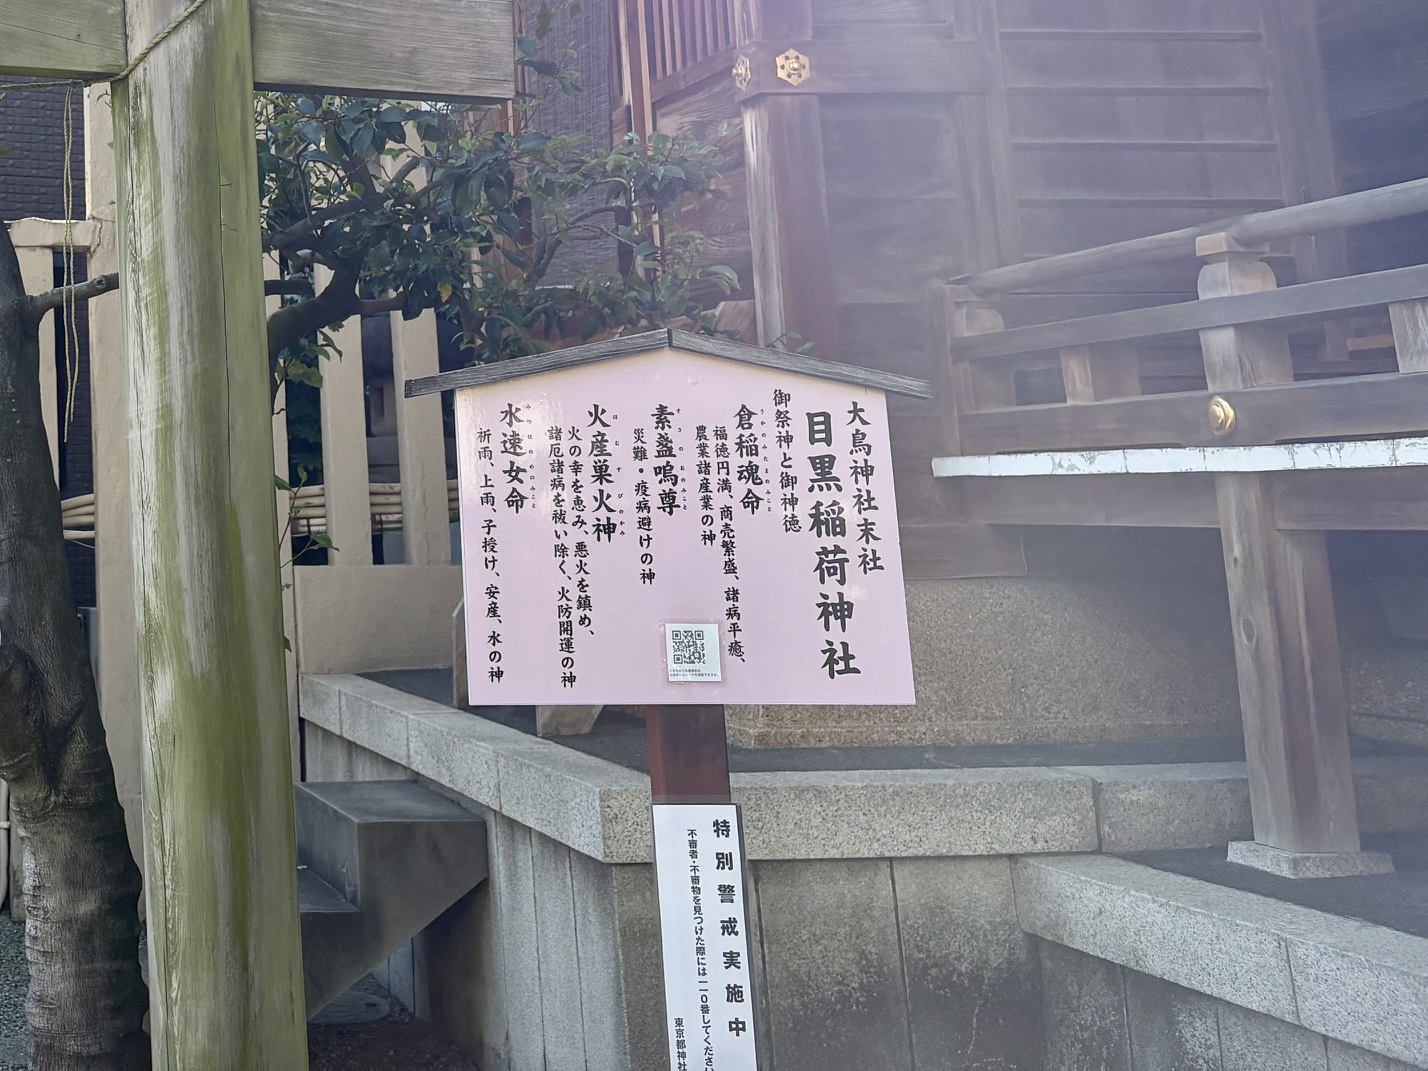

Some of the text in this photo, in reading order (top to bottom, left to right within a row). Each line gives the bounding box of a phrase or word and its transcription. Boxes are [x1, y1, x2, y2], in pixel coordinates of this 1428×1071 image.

[500, 403, 529, 514] 水速女命
[567, 426, 595, 635] 火の幸を恵み、悪火を鎮め、
[587, 404, 617, 543] 火産巣火神
[632, 428, 656, 585] 災難・疫病避けの神
[695, 425, 717, 546] 農業諸産業の神
[733, 404, 765, 515] 倉稲魂命
[772, 389, 802, 533] 御祭神と御神徳
[846, 401, 885, 575] 大鳥神社末社
[806, 411, 861, 679] 目黒稲荷神社
[713, 819, 747, 1037] 特別警戒実施中
